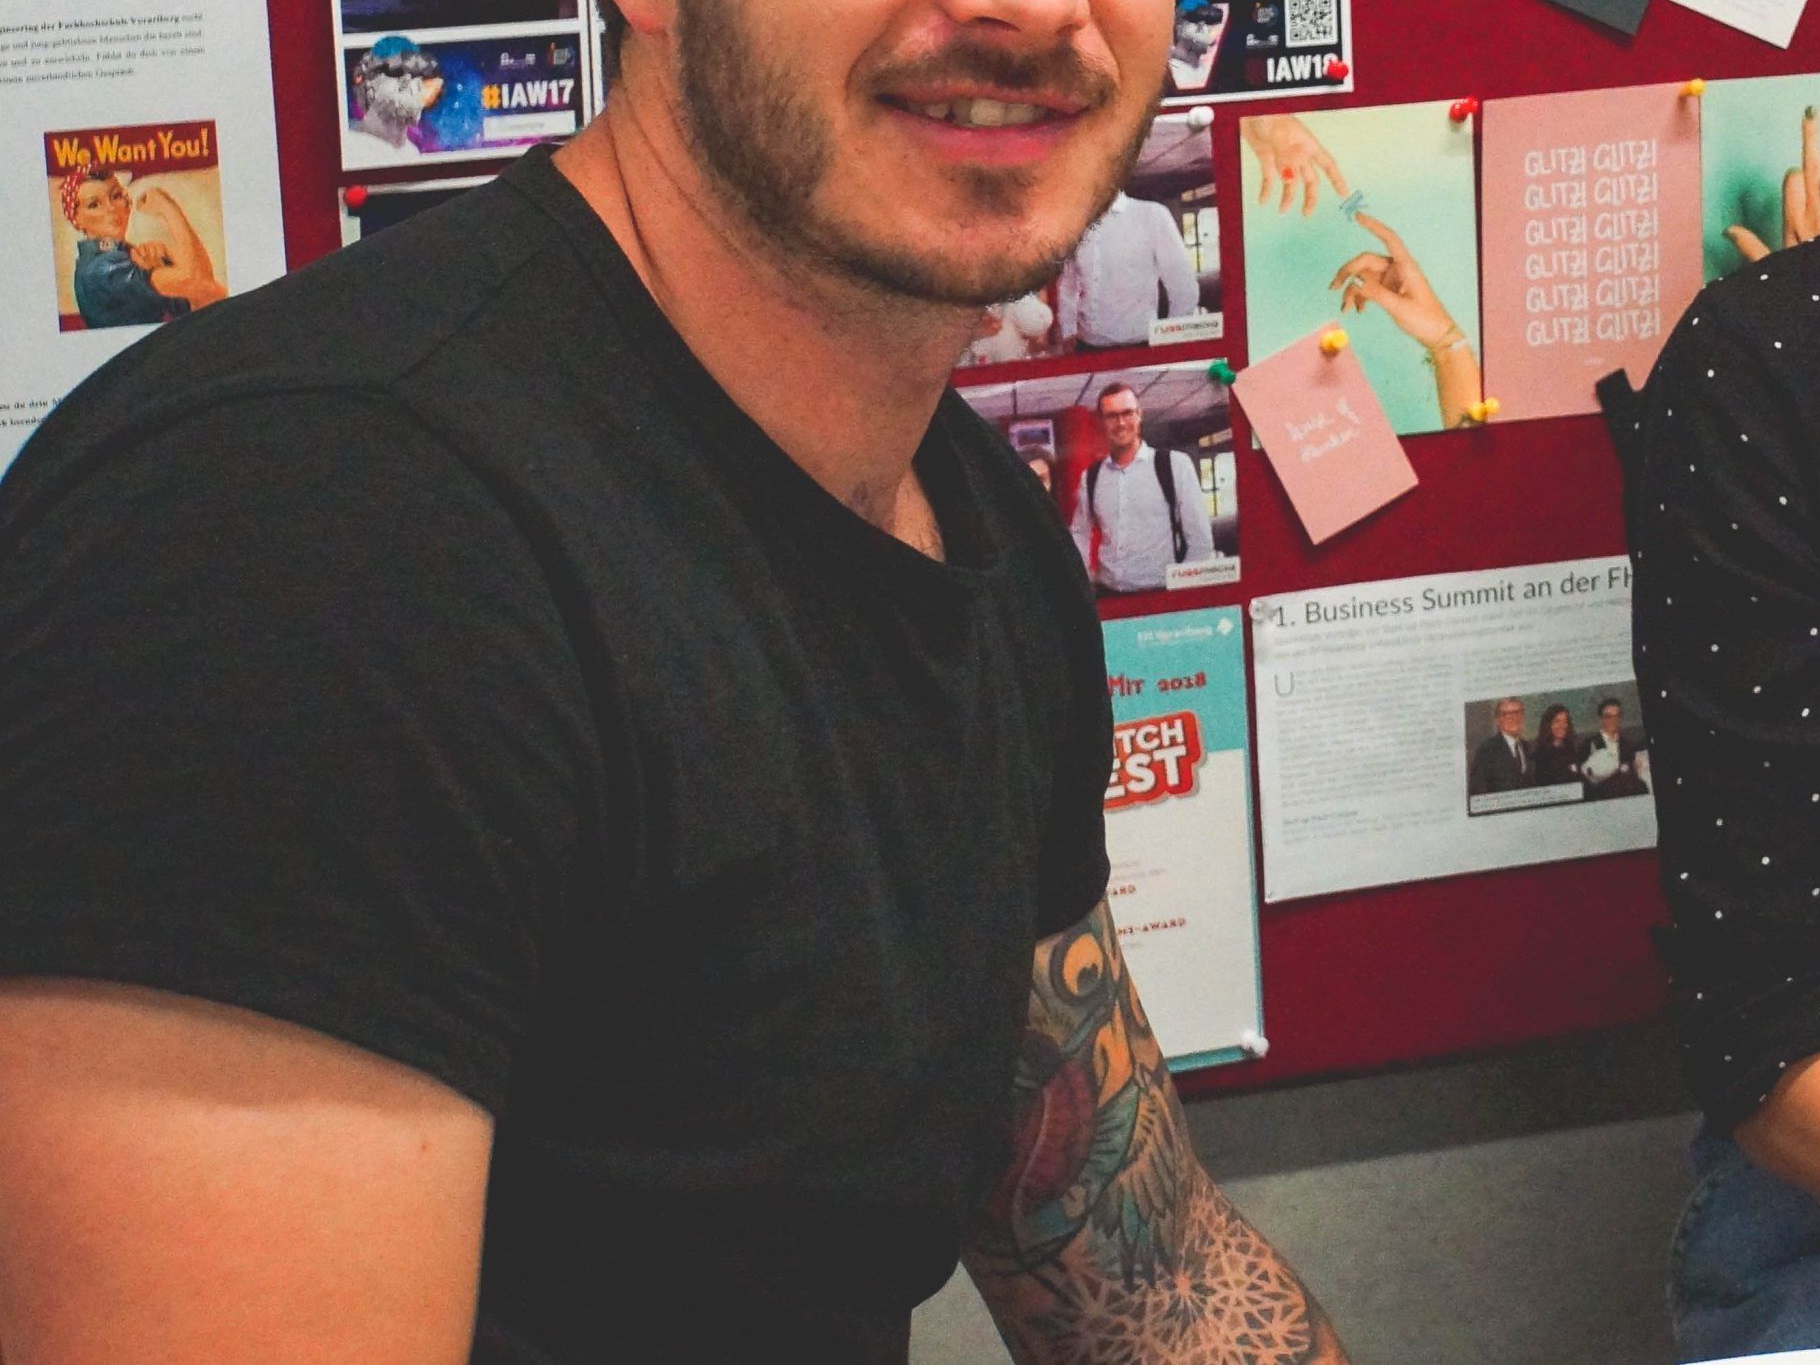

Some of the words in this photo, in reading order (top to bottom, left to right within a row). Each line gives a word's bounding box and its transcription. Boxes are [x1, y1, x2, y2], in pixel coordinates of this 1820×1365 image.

[482, 78, 575, 110] #IAW17
[54, 137, 91, 168] We
[94, 134, 156, 164] Want
[157, 128, 210, 160] You!
[1275, 606, 1296, 627] 1.
[1305, 597, 1414, 625] Business
[1422, 579, 1515, 611] Summit
[1523, 580, 1552, 600] an
[1560, 571, 1600, 595] der
[1158, 671, 1207, 693] 2018
[1114, 719, 1185, 757] TCH
